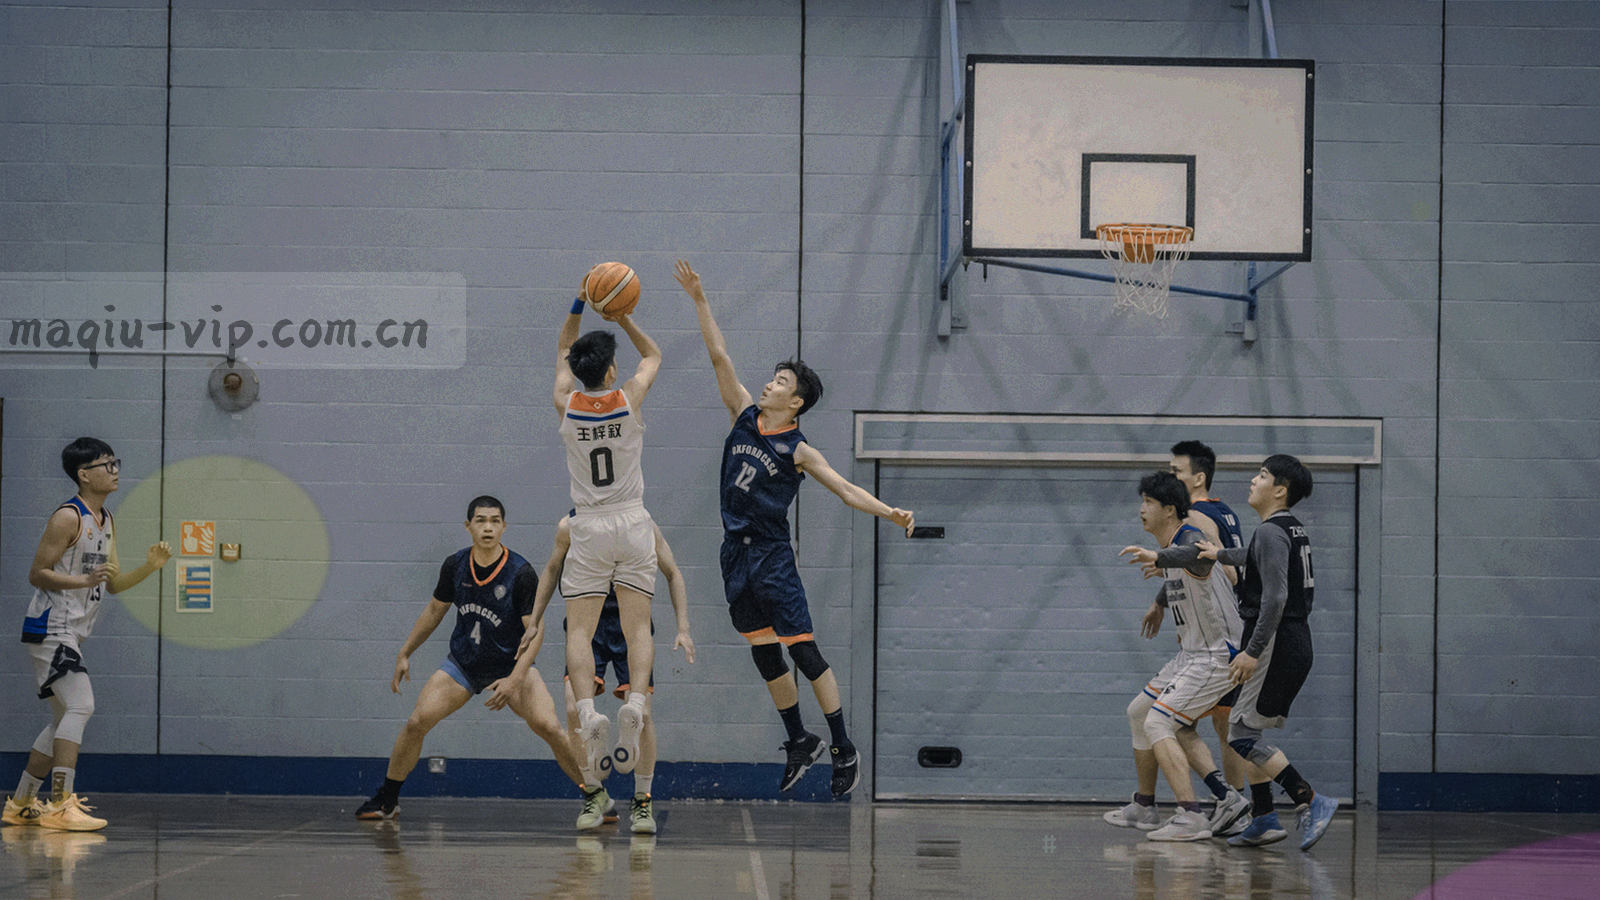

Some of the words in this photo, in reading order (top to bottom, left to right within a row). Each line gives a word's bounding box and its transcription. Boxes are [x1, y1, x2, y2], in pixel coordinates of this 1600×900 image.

[589, 446, 615, 488] 0
[735, 461, 757, 492] 12
[470, 620, 481, 645] 4
